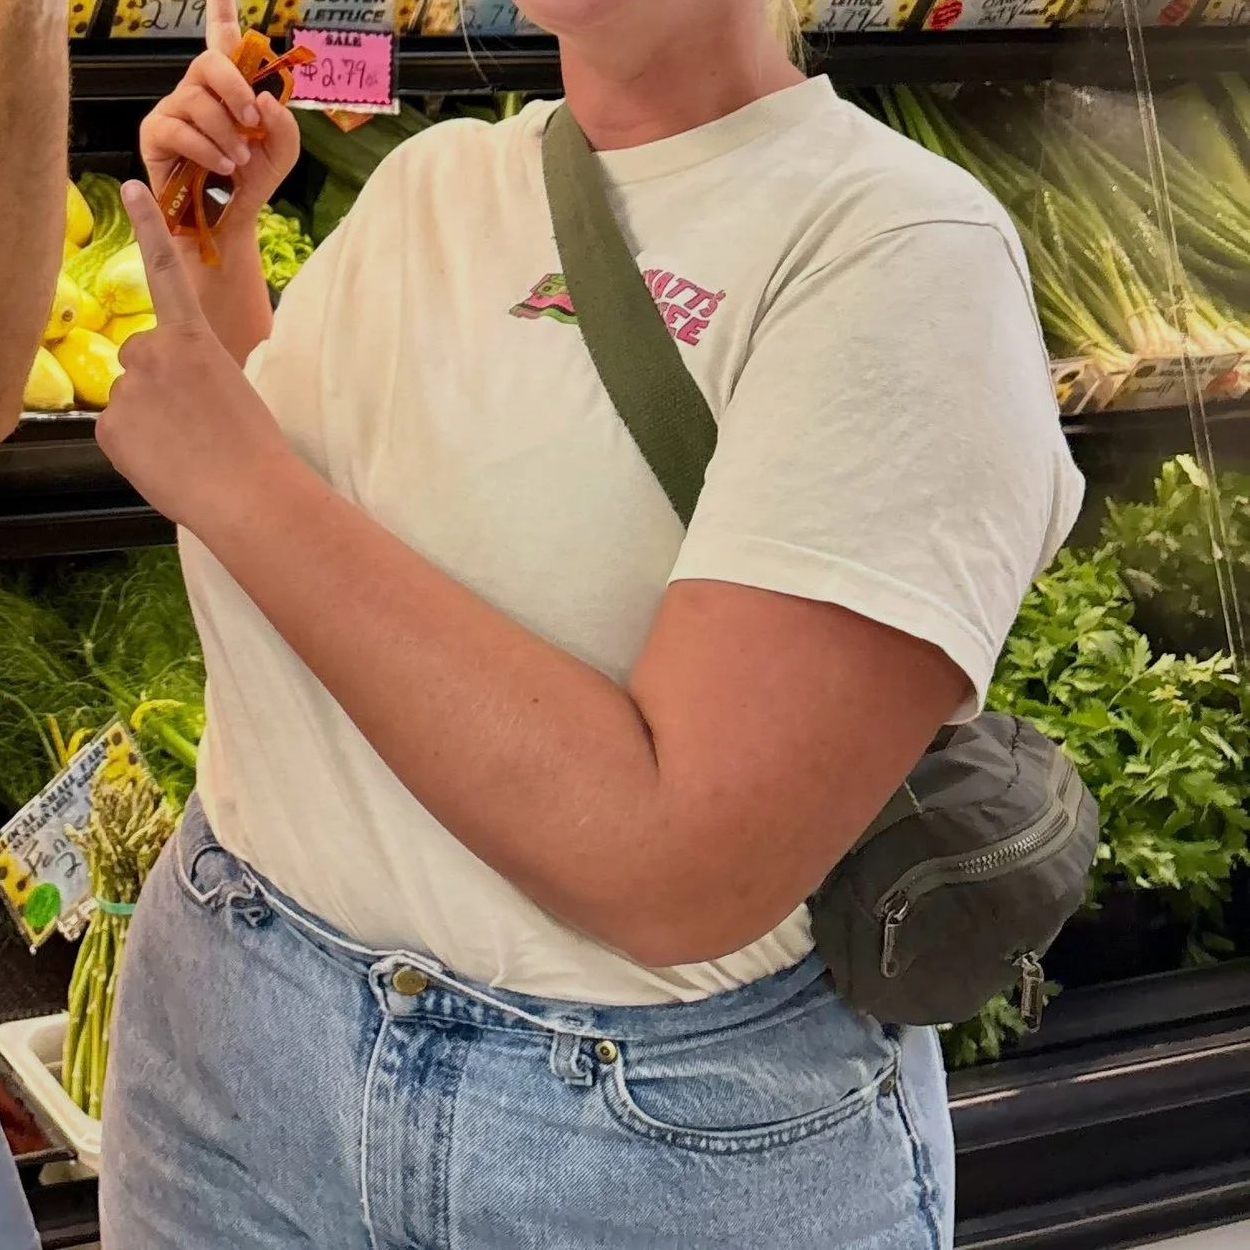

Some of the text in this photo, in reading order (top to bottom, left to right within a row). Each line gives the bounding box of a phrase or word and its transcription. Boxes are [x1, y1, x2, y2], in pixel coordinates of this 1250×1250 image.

[302, 8, 386, 24] LETTUCE
[324, 34, 363, 47] SALE
[167, 186, 190, 217] ROXY
